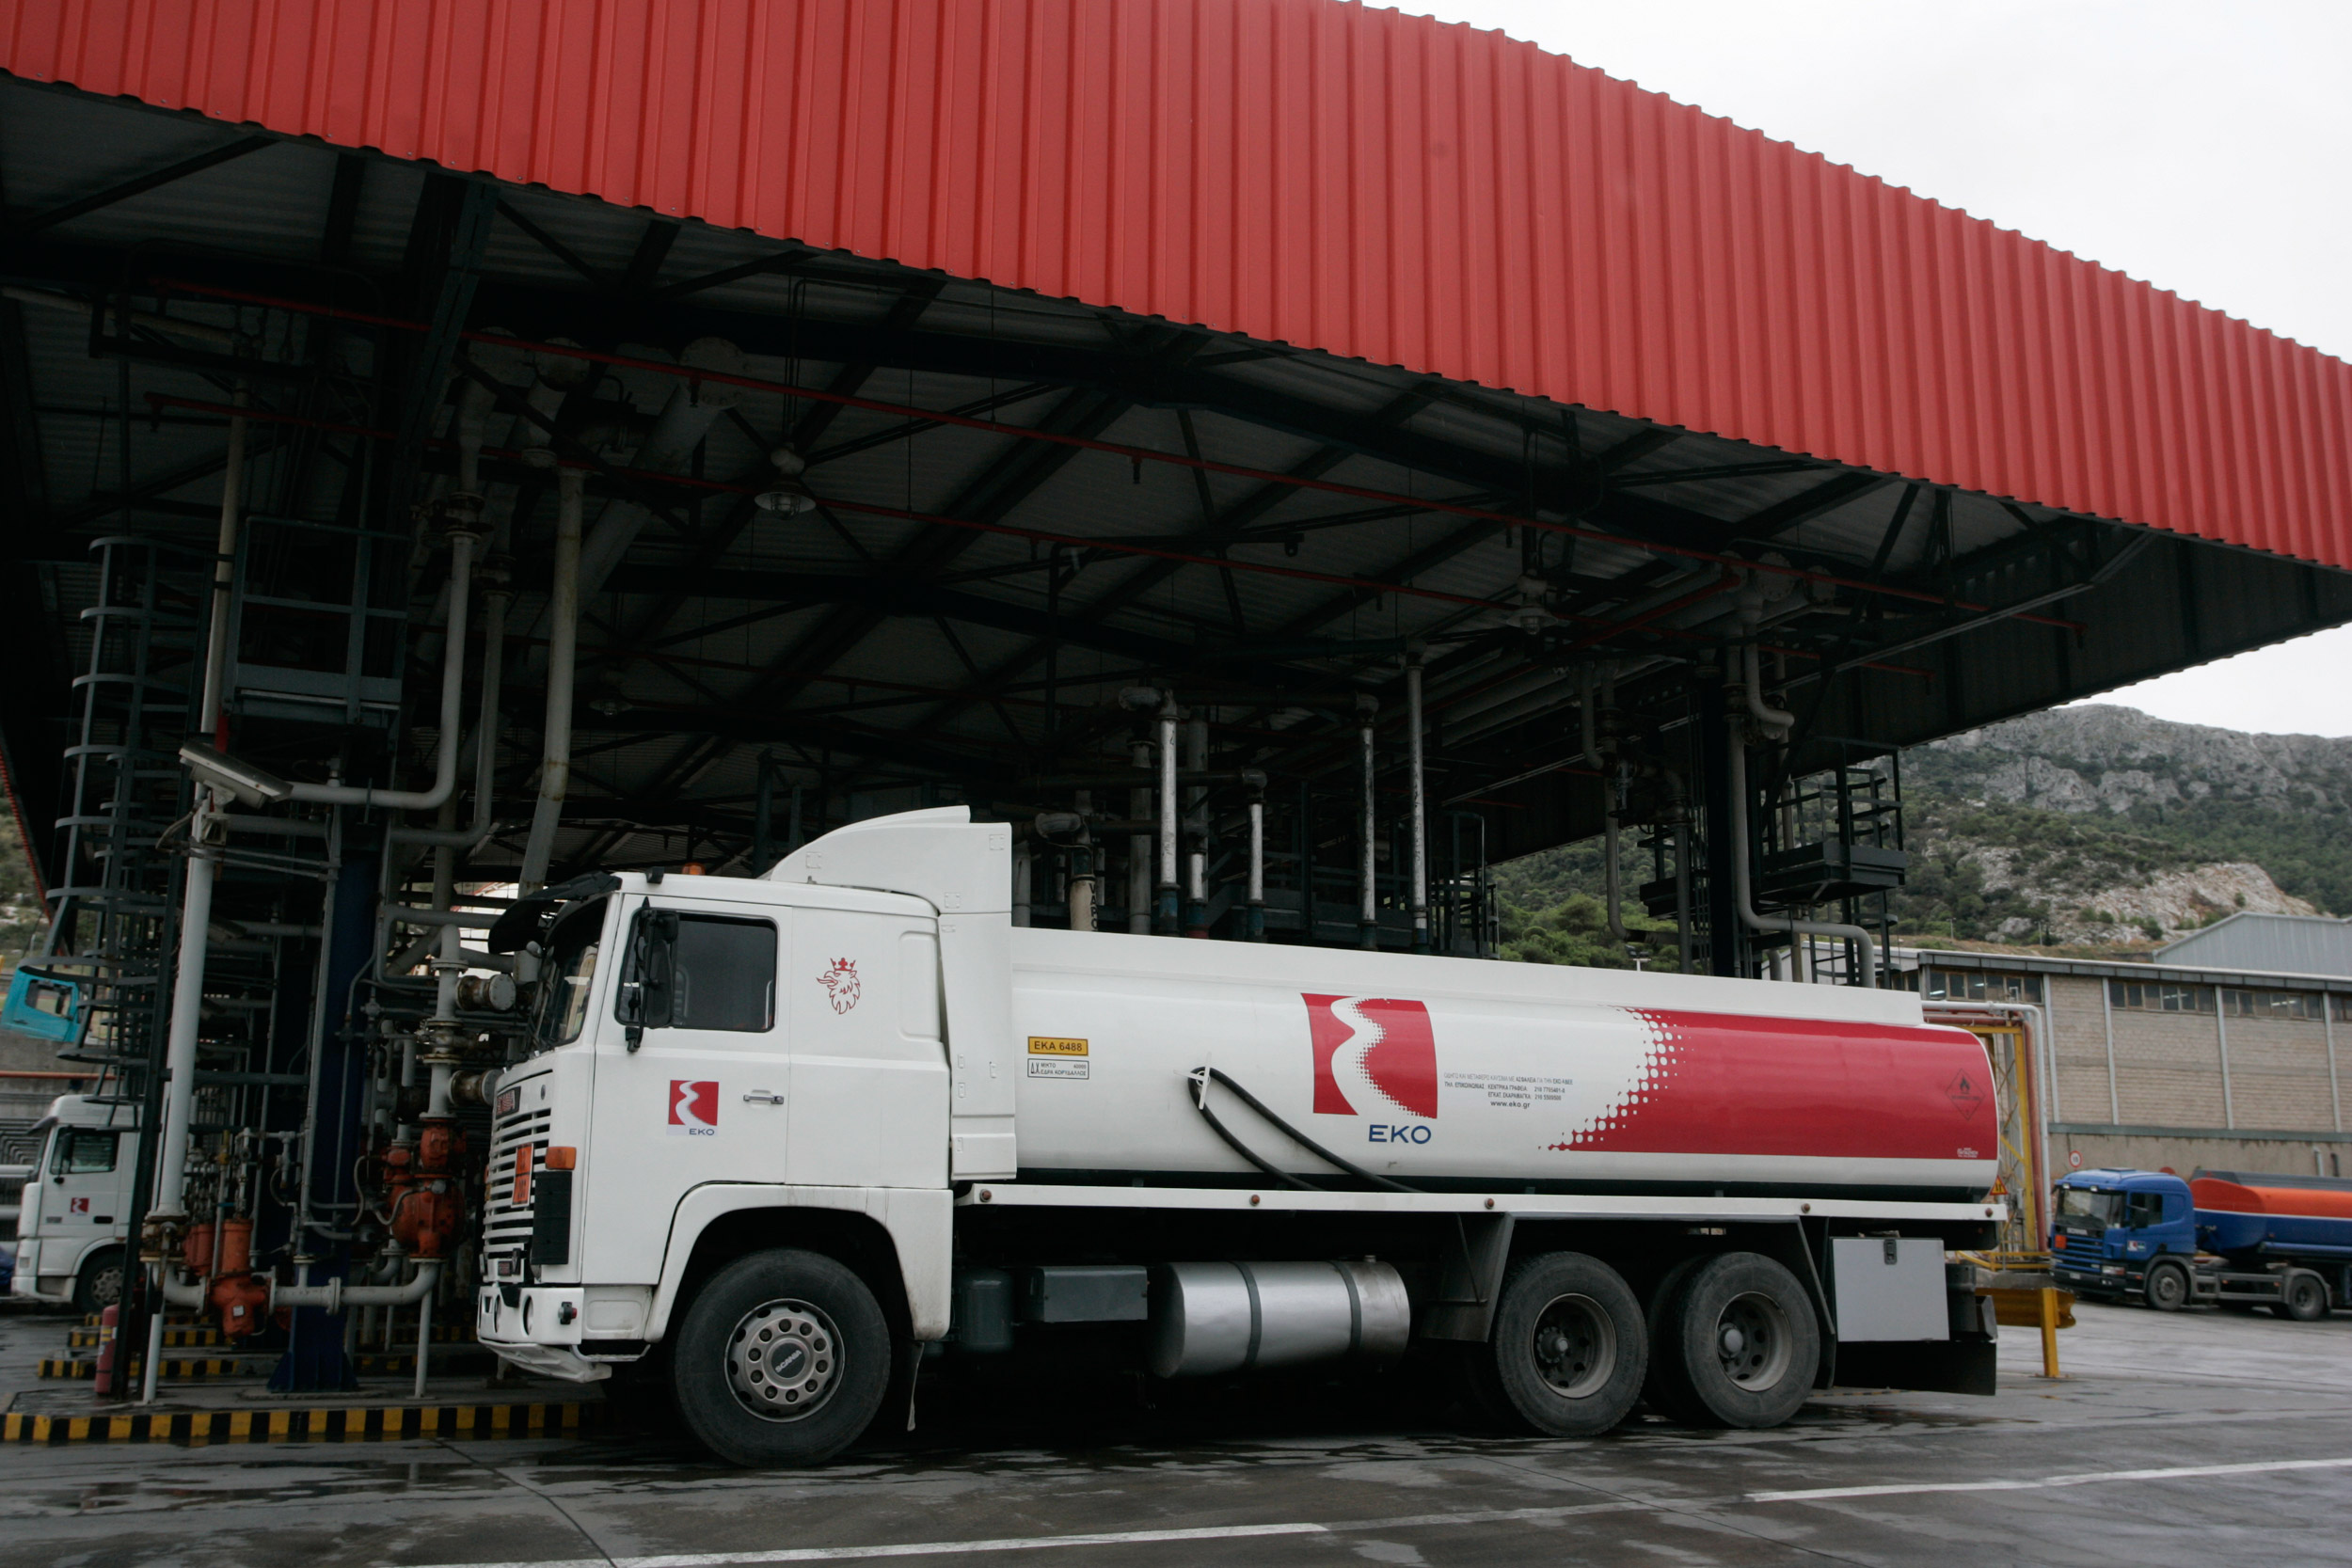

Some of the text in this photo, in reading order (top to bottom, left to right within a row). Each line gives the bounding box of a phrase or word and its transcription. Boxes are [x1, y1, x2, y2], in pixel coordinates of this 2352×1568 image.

[1089, 882, 1099, 931] VAPO
[1034, 1040, 1083, 1052] EKA 6488
[1490, 1101, 1531, 1109] www.eko.gr
[689, 1128, 715, 1136] EKO
[1369, 1124, 1432, 1145] EKO
[775, 1350, 802, 1372] SCANIA
